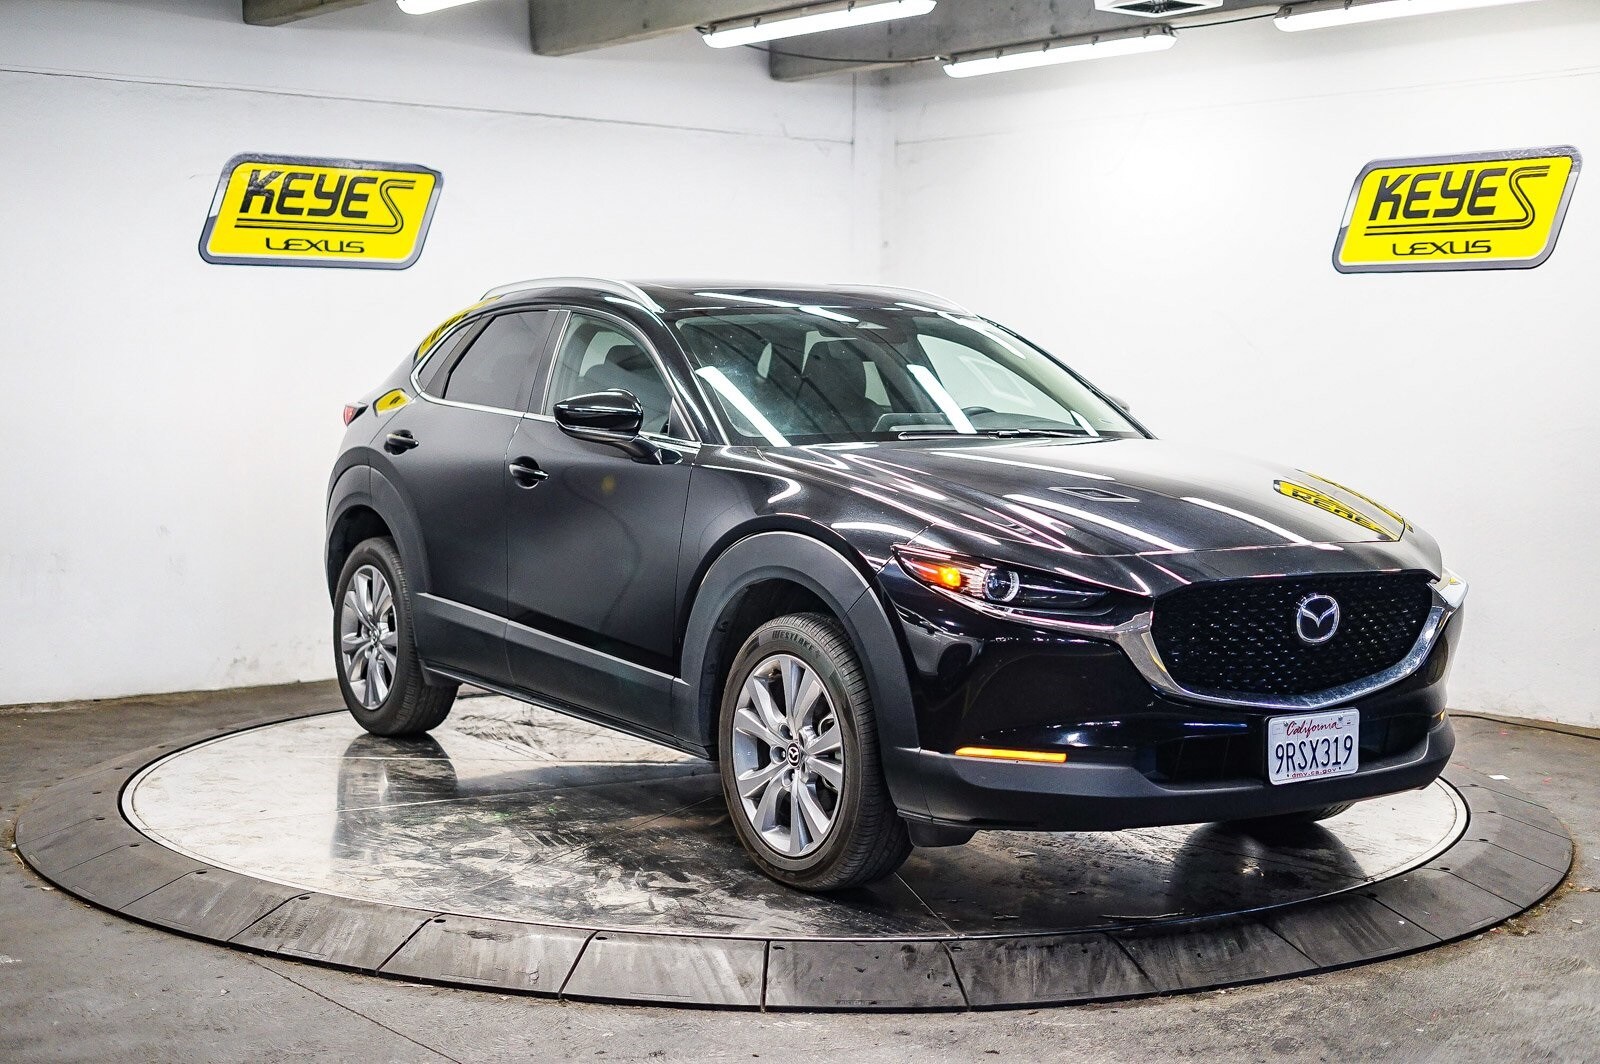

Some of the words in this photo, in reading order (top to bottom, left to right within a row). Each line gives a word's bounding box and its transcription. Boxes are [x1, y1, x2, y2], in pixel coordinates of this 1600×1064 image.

[235, 169, 417, 234] KEYES
[1364, 165, 1550, 235] KEYES
[265, 237, 365, 253] LEXUS
[1392, 240, 1491, 256] LEXUS
[1286, 720, 1343, 738] California
[1275, 735, 1353, 774] 9RSX319
[1291, 767, 1337, 779] dmv.ca.gov
